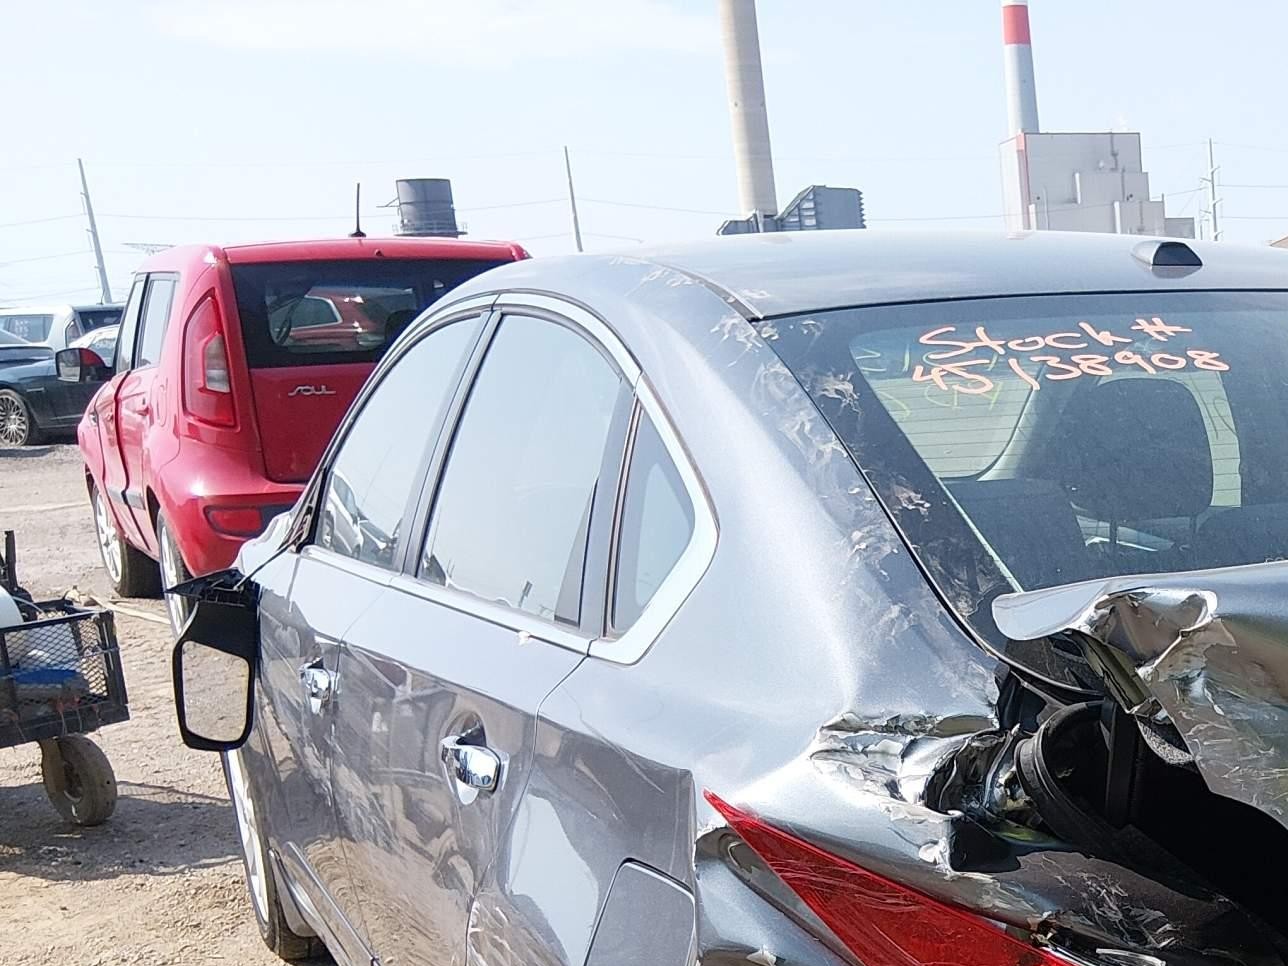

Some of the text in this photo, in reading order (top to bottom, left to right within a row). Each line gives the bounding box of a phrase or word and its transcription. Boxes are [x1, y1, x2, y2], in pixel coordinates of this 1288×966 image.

[918, 321, 1133, 360] Stock
[1130, 316, 1193, 343] #
[287, 384, 337, 397] SOUL
